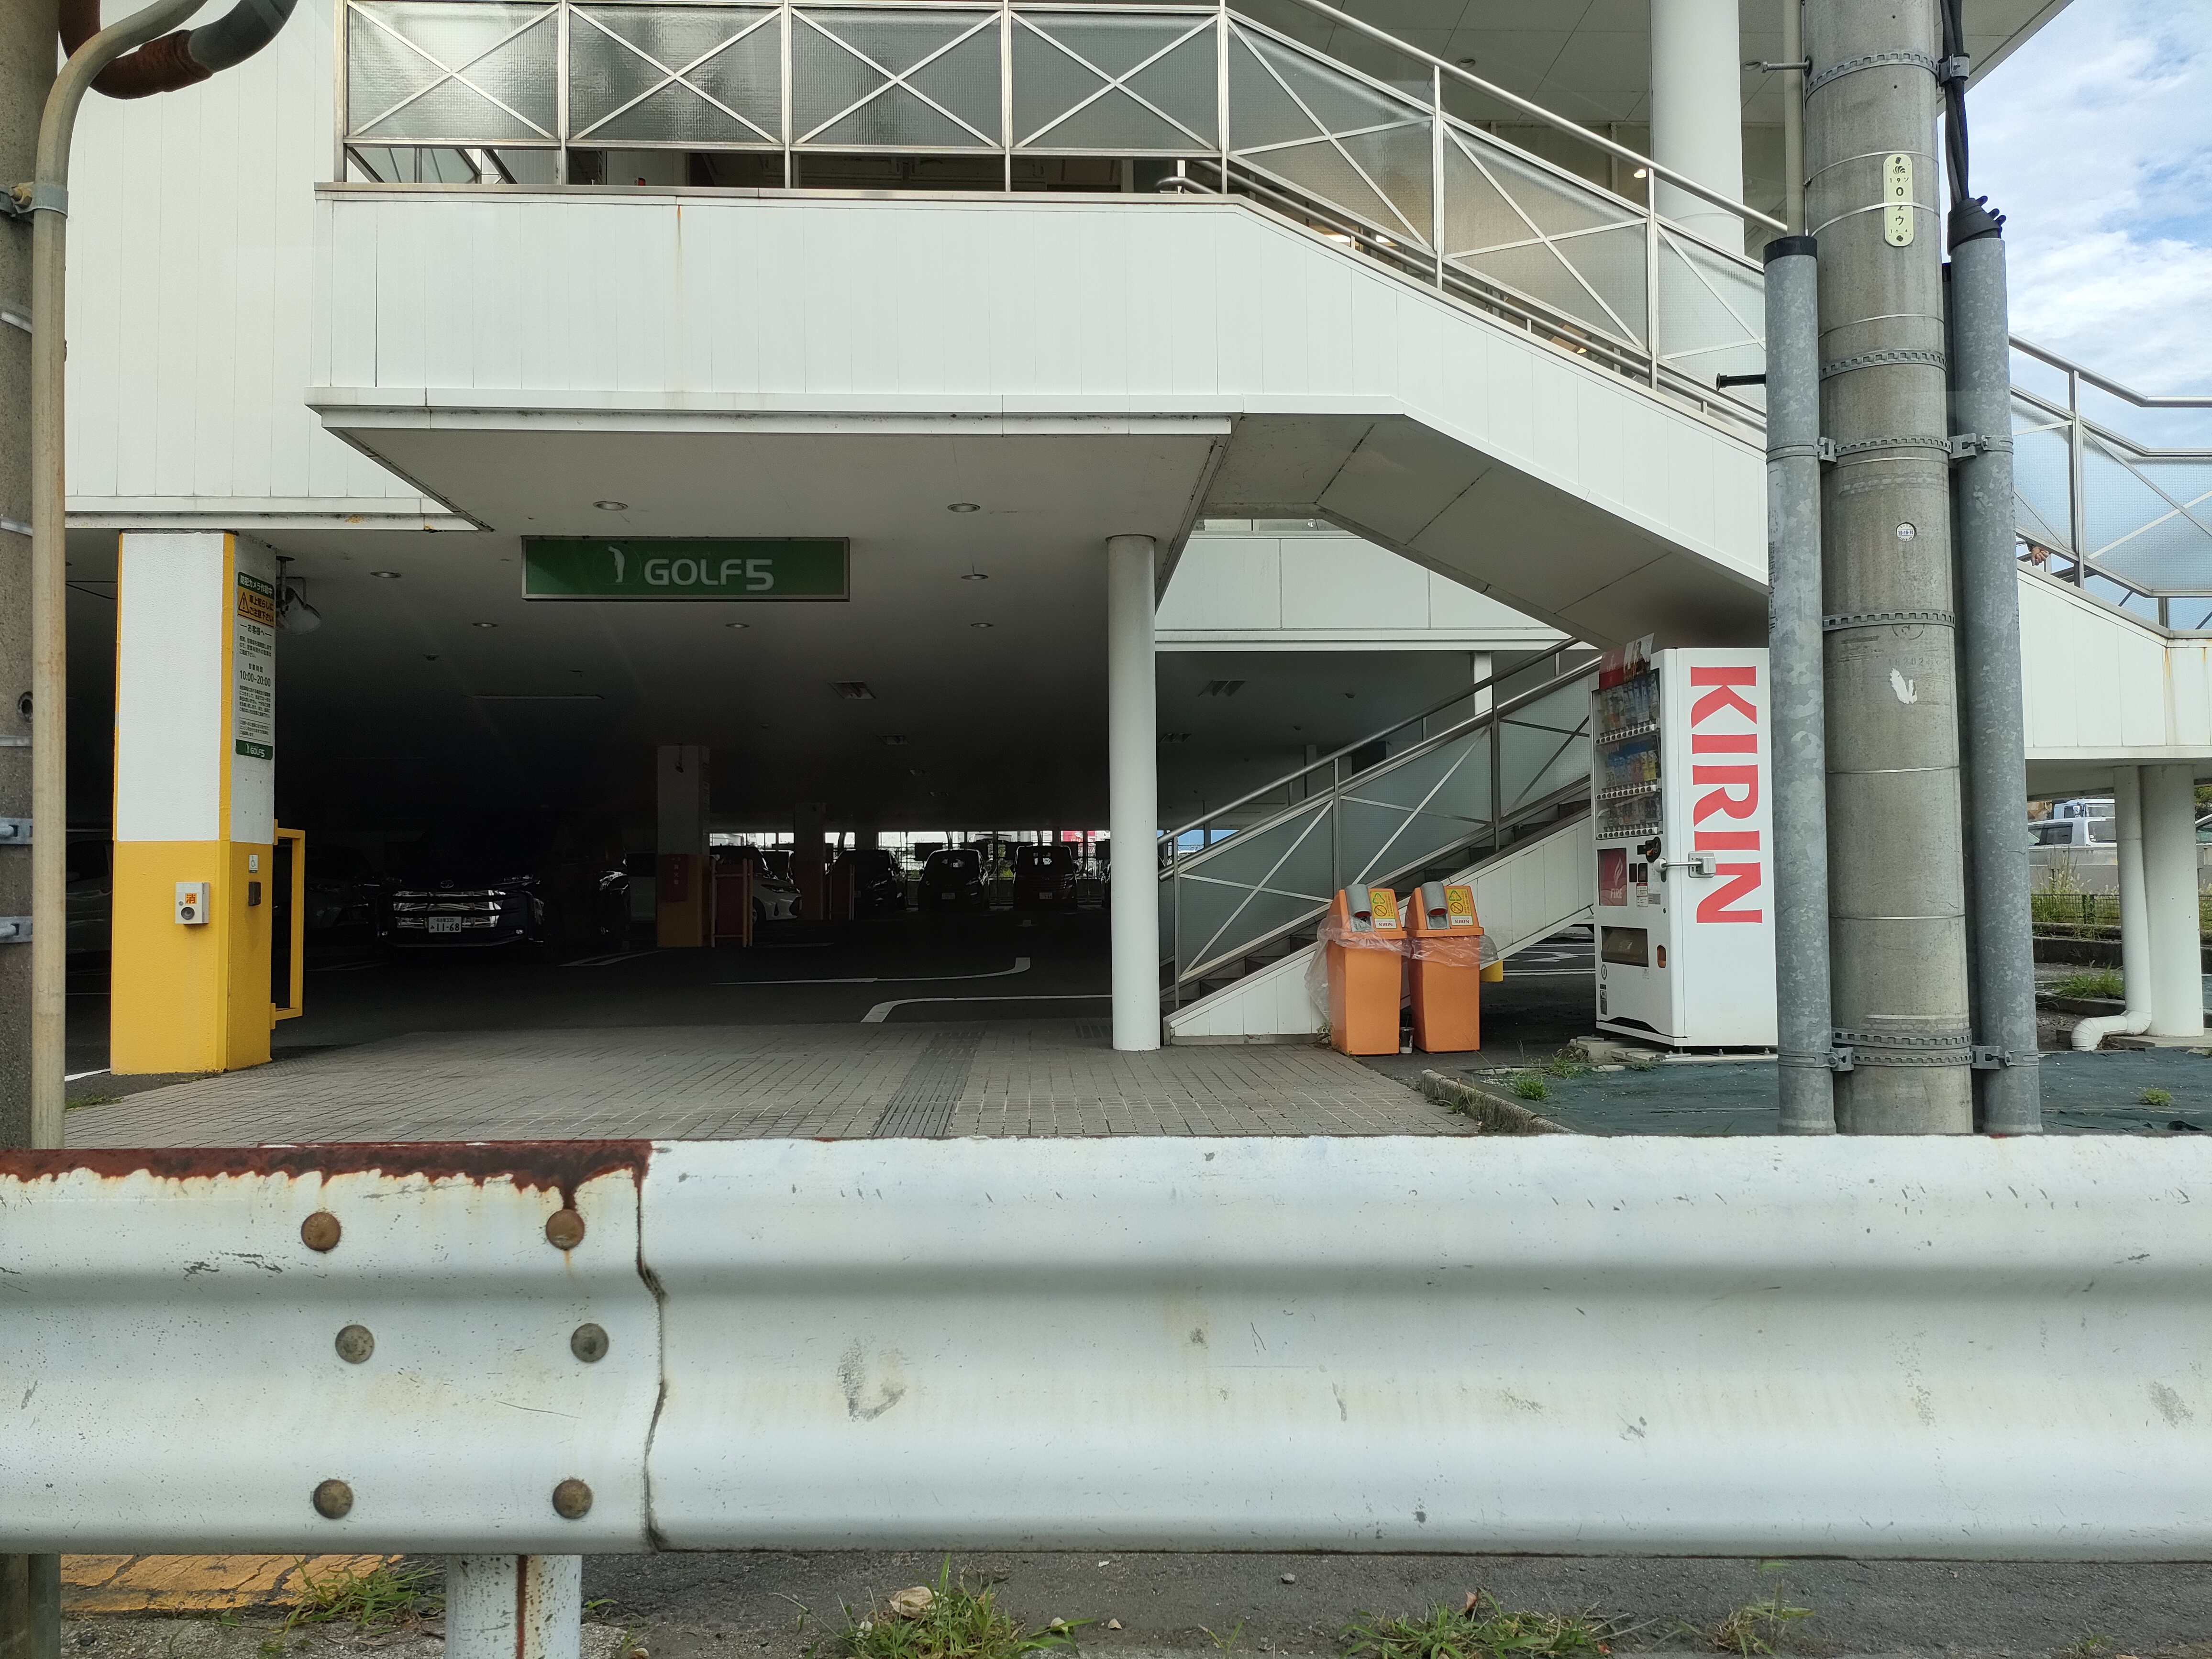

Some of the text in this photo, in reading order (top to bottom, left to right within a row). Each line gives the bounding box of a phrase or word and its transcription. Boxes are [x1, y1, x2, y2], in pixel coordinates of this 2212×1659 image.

[644, 558, 774, 591] GOLF5
[240, 574, 273, 596] 防犯カメラ作動中
[249, 595, 274, 611] 車上荒らしに
[250, 747, 265, 758] GOLF5
[1690, 666, 1763, 924] KIRIN
[186, 894, 196, 904] 消
[1611, 888, 1623, 899] FIRE
[437, 923, 459, 931] 11-68
